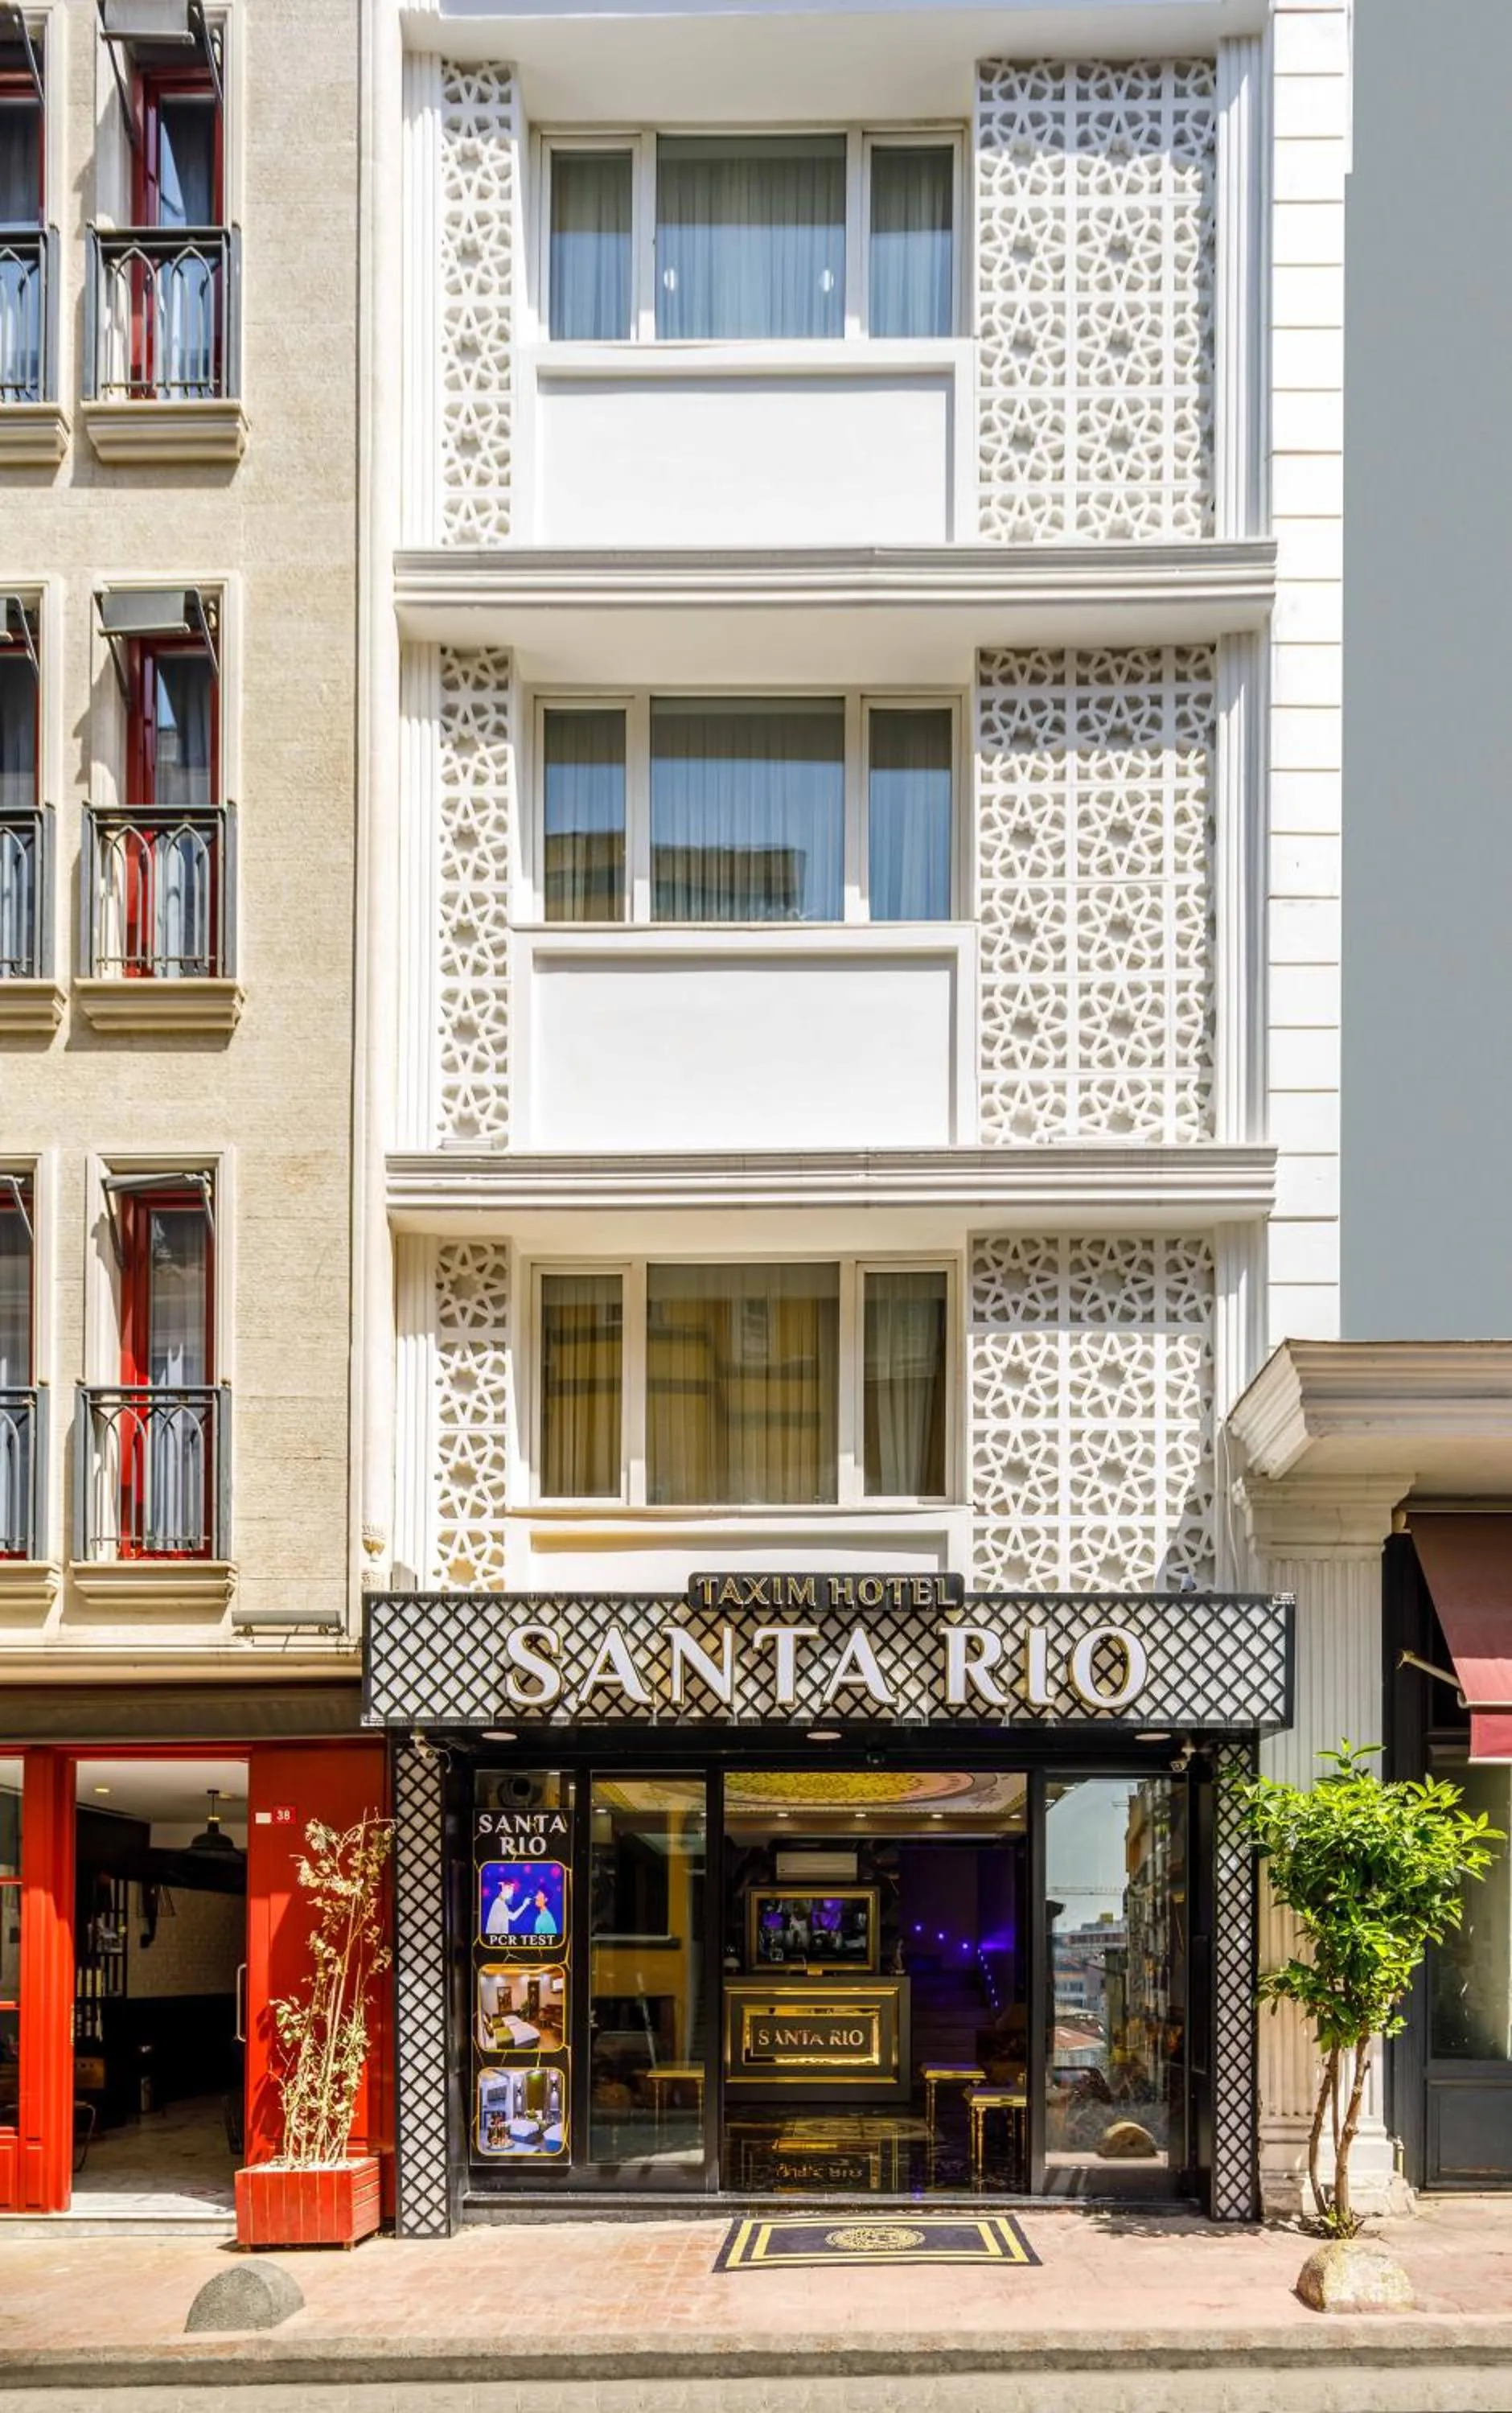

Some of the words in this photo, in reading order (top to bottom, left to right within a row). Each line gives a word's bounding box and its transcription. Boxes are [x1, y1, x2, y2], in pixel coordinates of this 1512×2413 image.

[696, 1576, 816, 1607] TAXIM
[828, 1576, 957, 1607] HOTEL
[505, 1623, 899, 1708] SANTA
[936, 1624, 1148, 1709] RIO
[276, 1809, 290, 1821] 38
[479, 1814, 567, 1834] SANTA
[499, 1835, 547, 1856] RIO
[488, 1934, 518, 1946] PCR
[520, 1934, 556, 1946] TEST
[758, 2029, 824, 2046] SANTA
[829, 2029, 864, 2046] RIO
